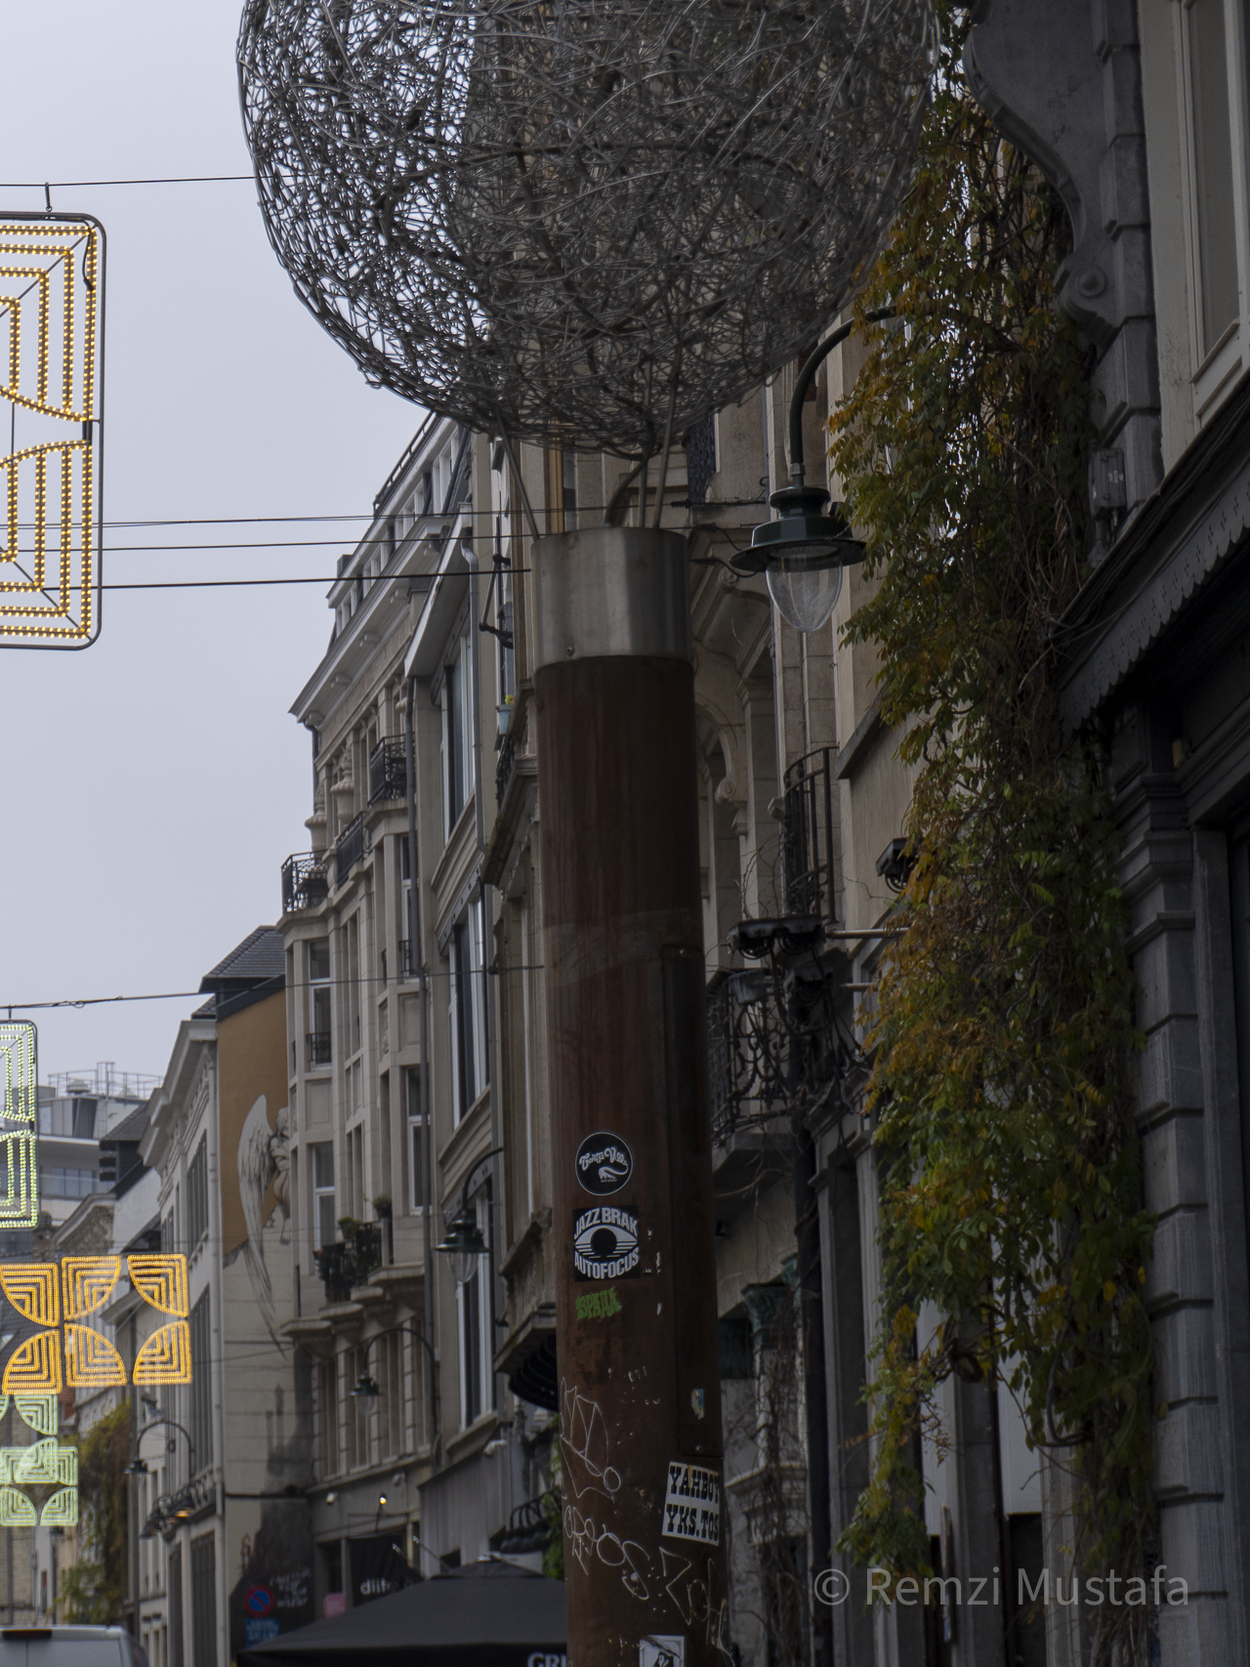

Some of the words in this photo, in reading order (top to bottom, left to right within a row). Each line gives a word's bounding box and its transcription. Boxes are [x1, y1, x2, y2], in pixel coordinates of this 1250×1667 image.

[574, 1208, 600, 1240] JAZZ
[601, 1207, 638, 1239] BRAK
[574, 1246, 640, 1280] AUTOFOCUS
